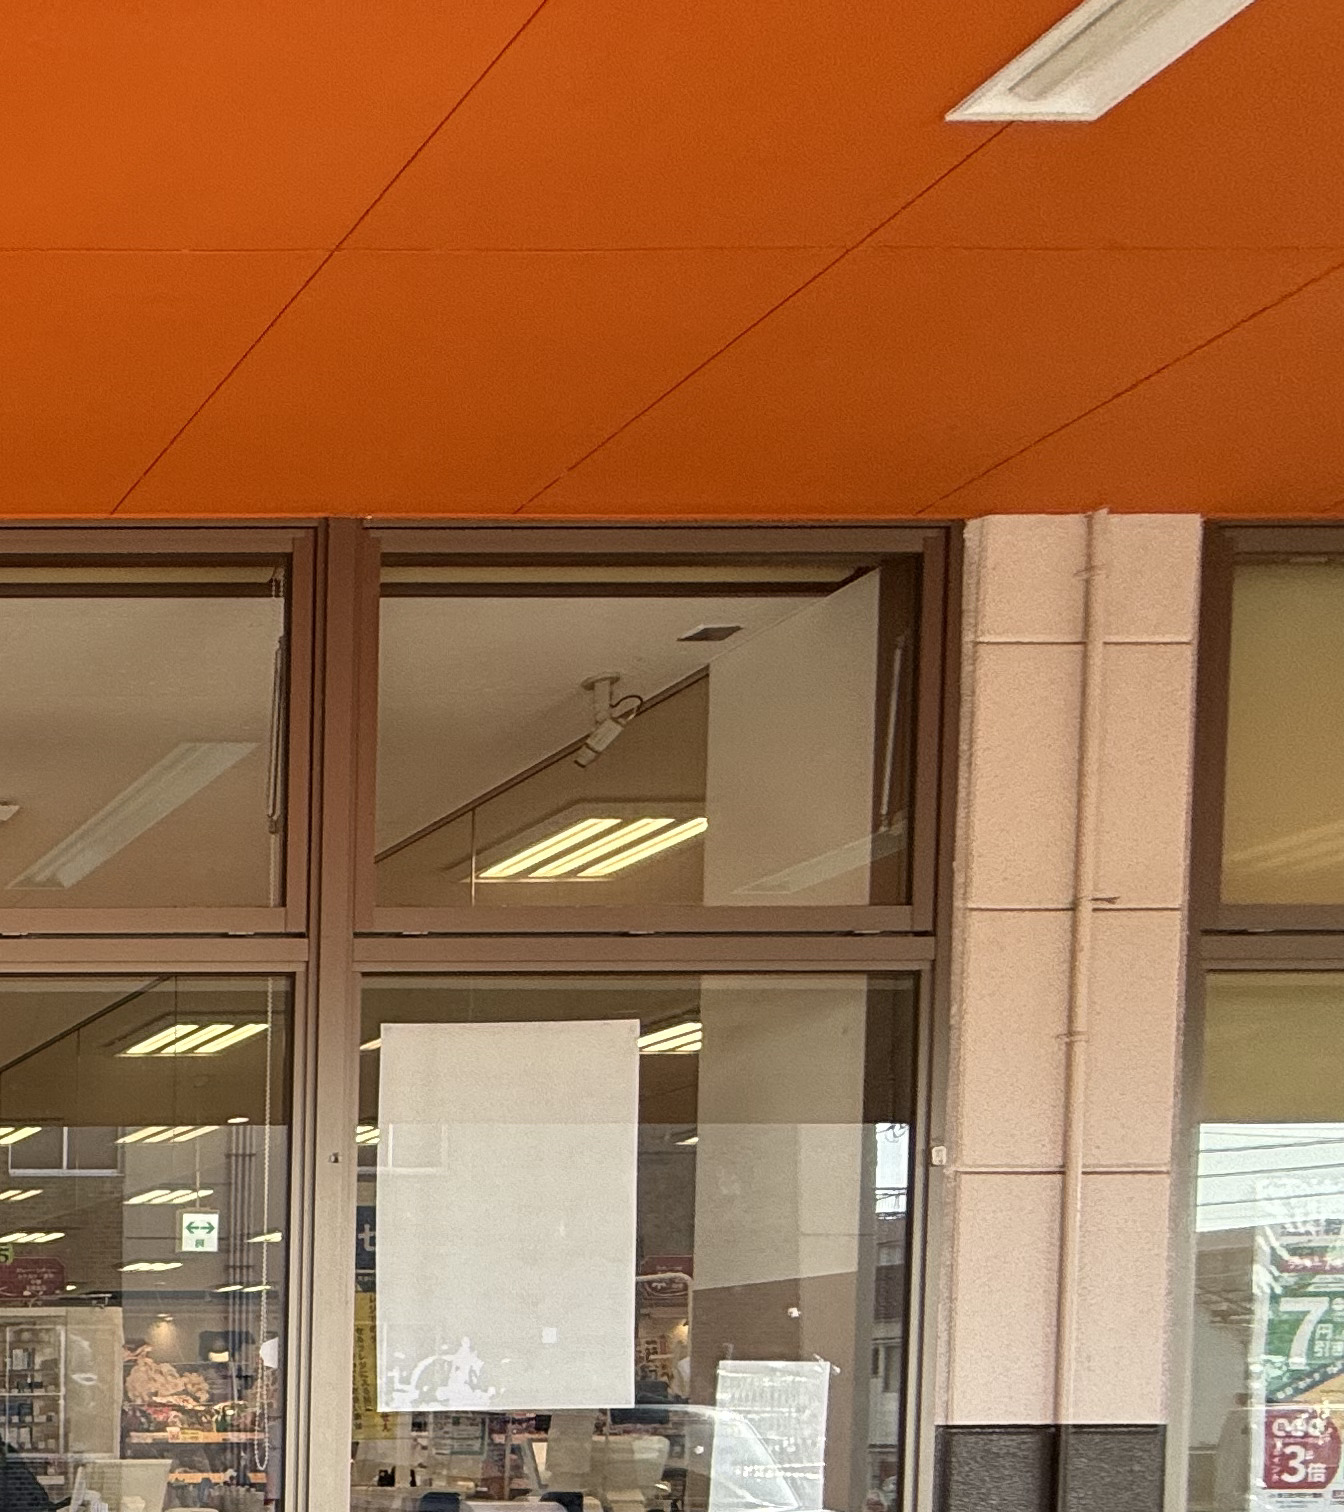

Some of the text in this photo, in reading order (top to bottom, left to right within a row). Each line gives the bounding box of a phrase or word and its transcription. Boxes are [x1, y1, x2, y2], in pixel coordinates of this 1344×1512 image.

[1279, 1296, 1330, 1369] 7
[1280, 1444, 1327, 1483] 3 倍
